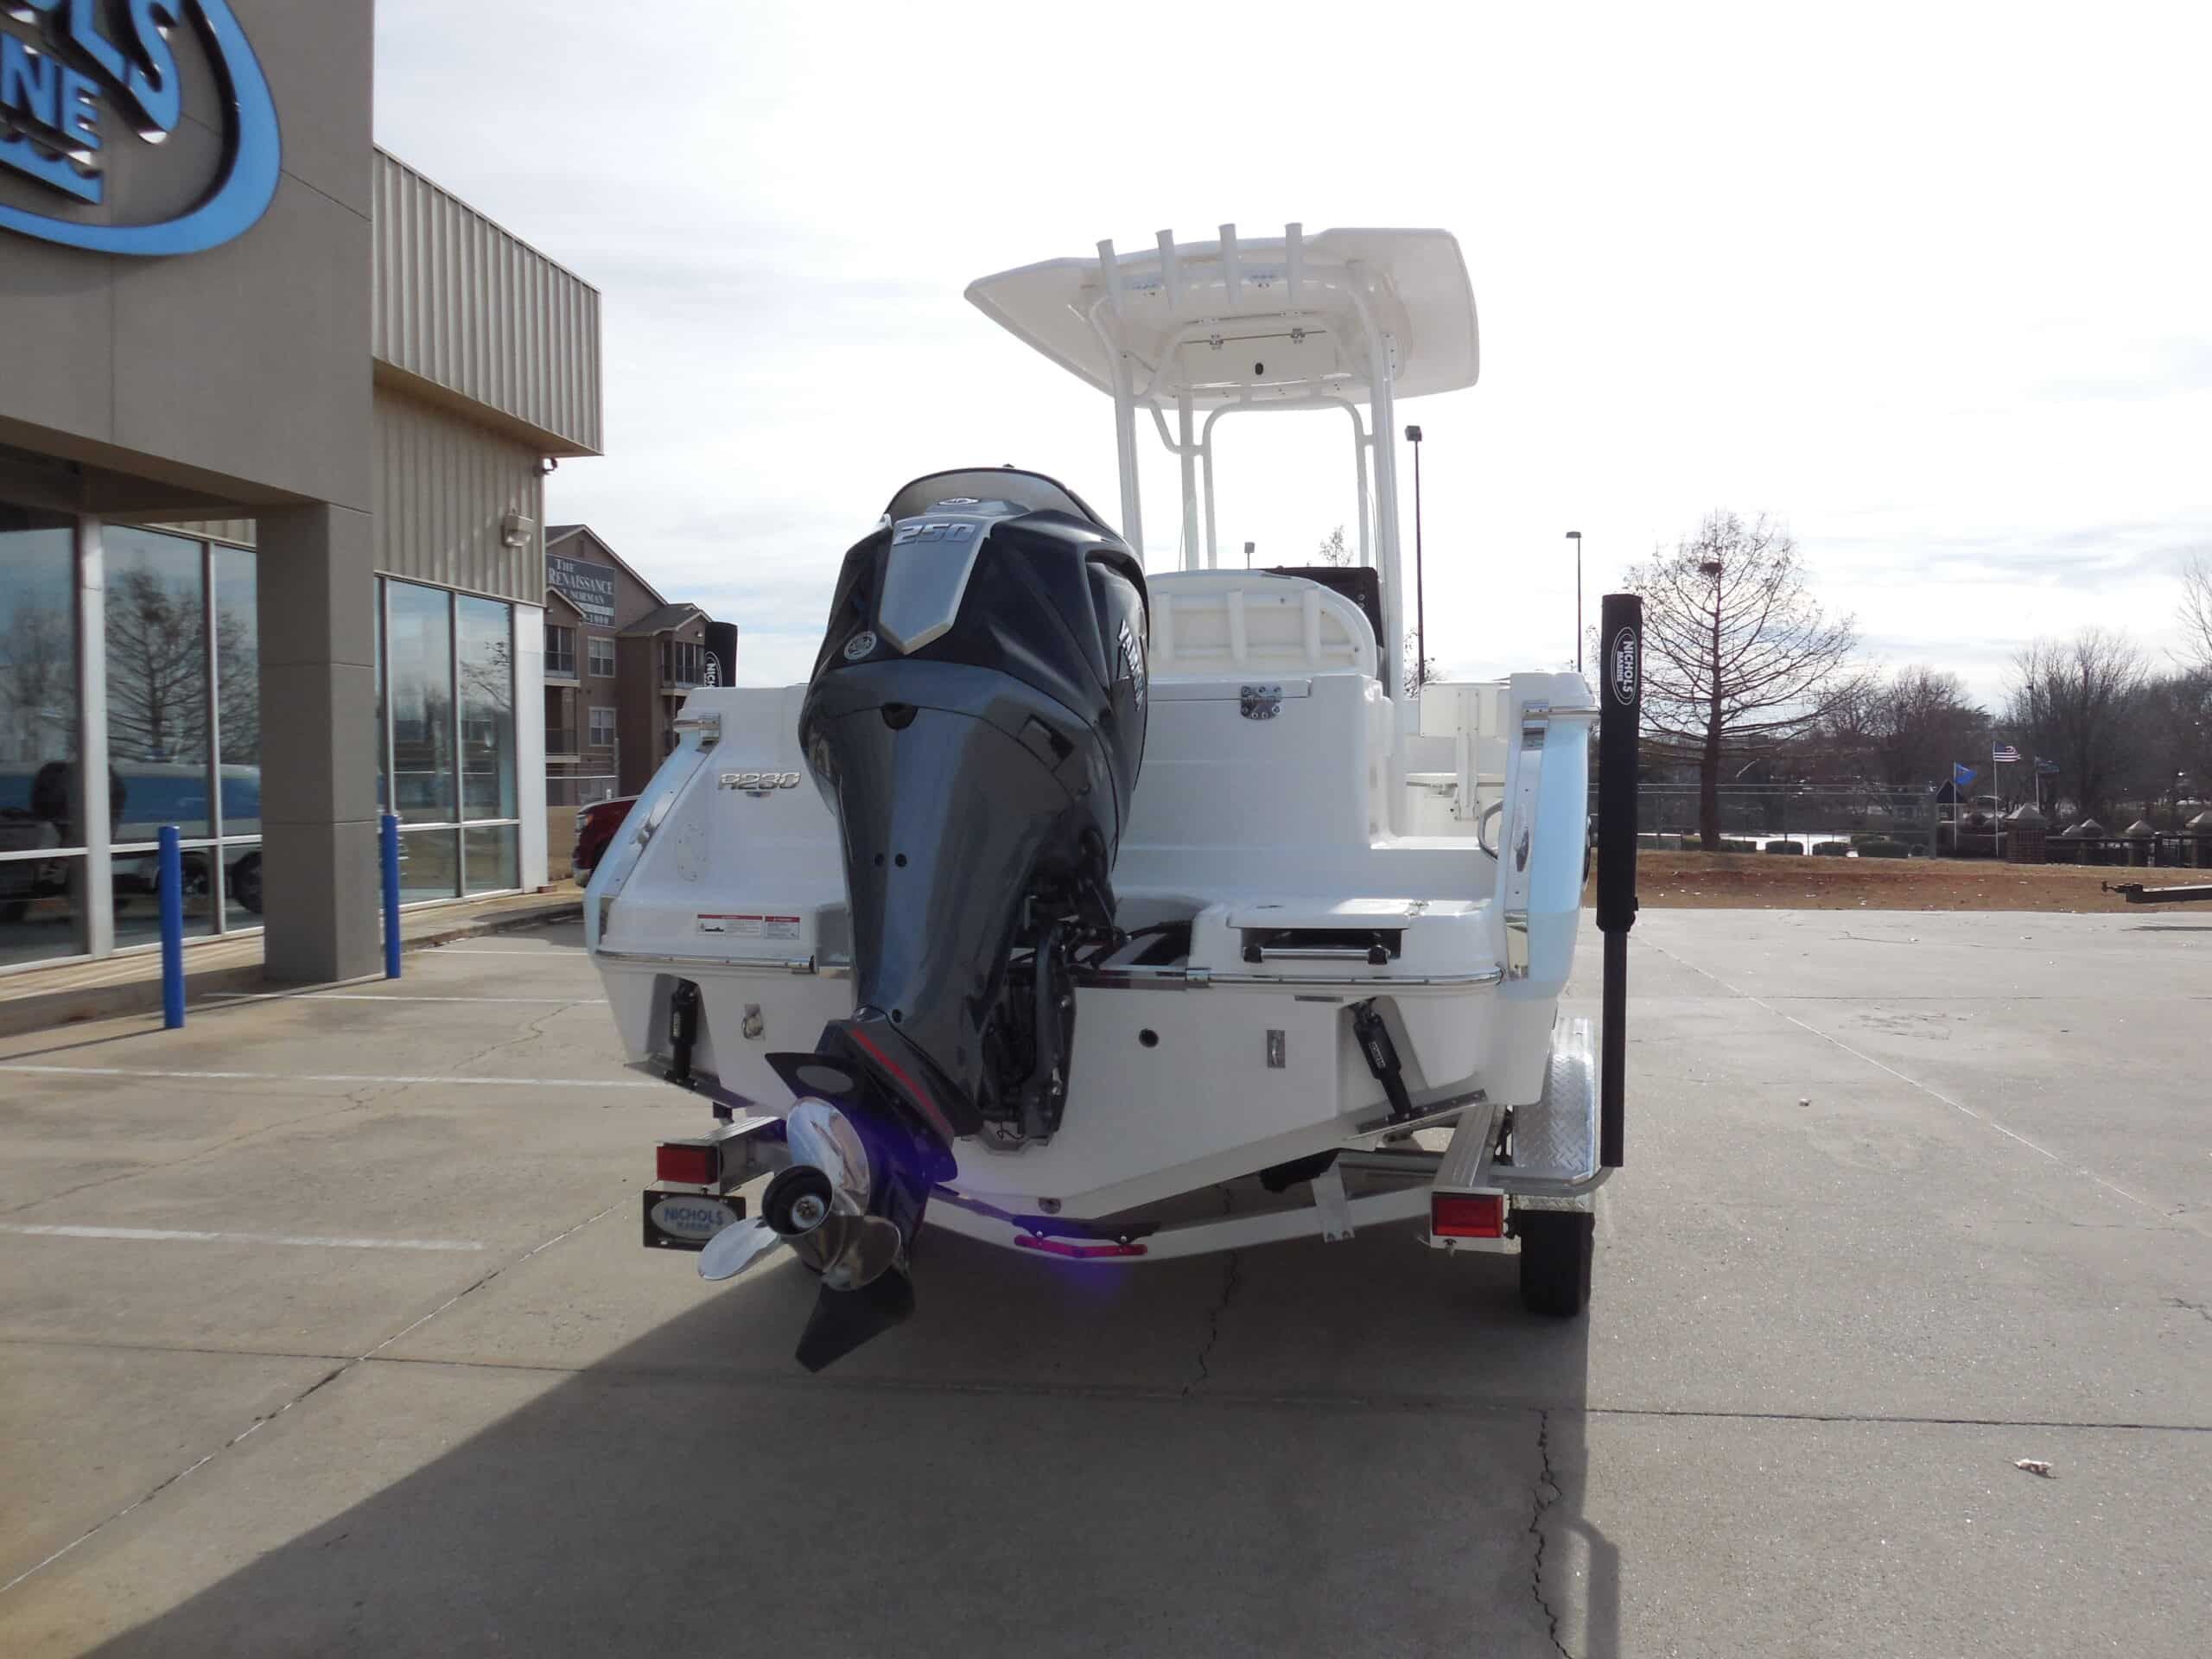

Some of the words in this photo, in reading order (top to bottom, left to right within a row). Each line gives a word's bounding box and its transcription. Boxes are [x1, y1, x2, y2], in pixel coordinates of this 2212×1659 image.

[893, 524, 976, 545] 250
[549, 567, 613, 595] RENAISSANCE
[1623, 640, 1634, 693] NICHOLS
[663, 1207, 724, 1226] NICHOLS
